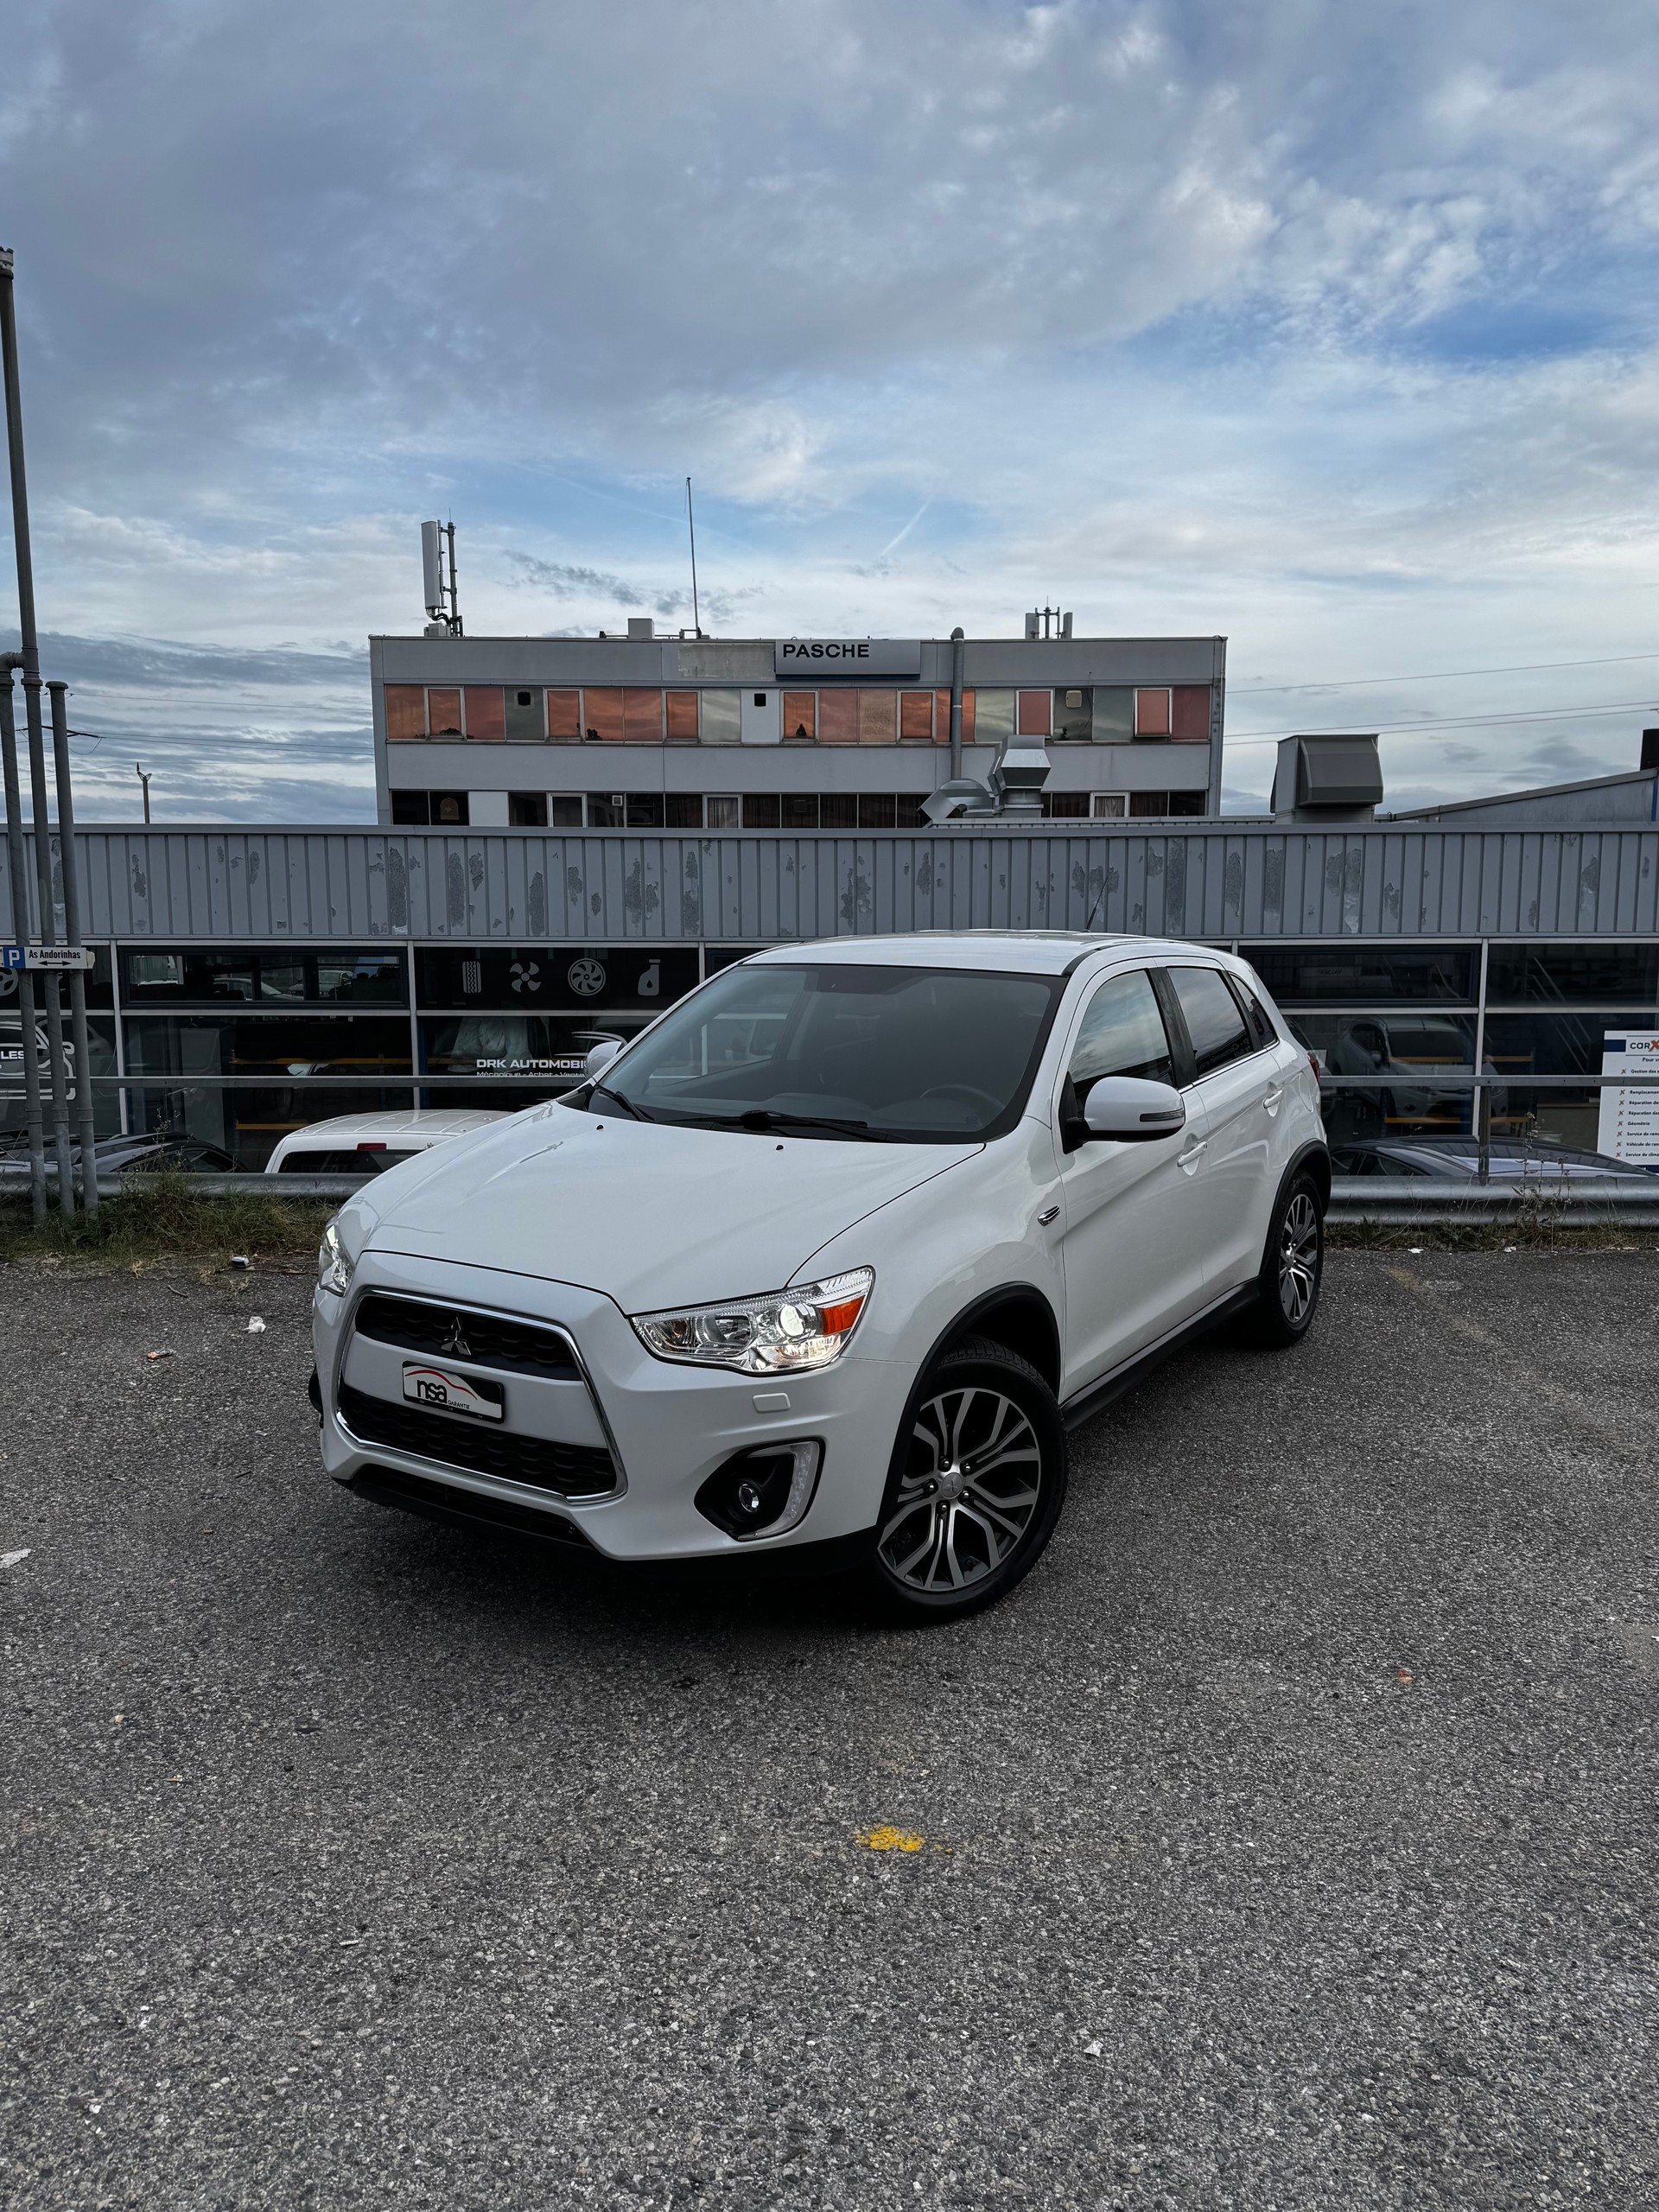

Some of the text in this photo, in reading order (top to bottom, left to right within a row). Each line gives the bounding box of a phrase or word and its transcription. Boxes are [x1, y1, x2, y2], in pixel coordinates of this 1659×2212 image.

[783, 644, 869, 658] PASCHE
[9, 950, 20, 967] P
[29, 950, 81, 959] As Andorinhas
[476, 1059, 587, 1069] DRK AUTOMOBI
[416, 1379, 448, 1404] nsa
[448, 1400, 471, 1410] GARANTIE
